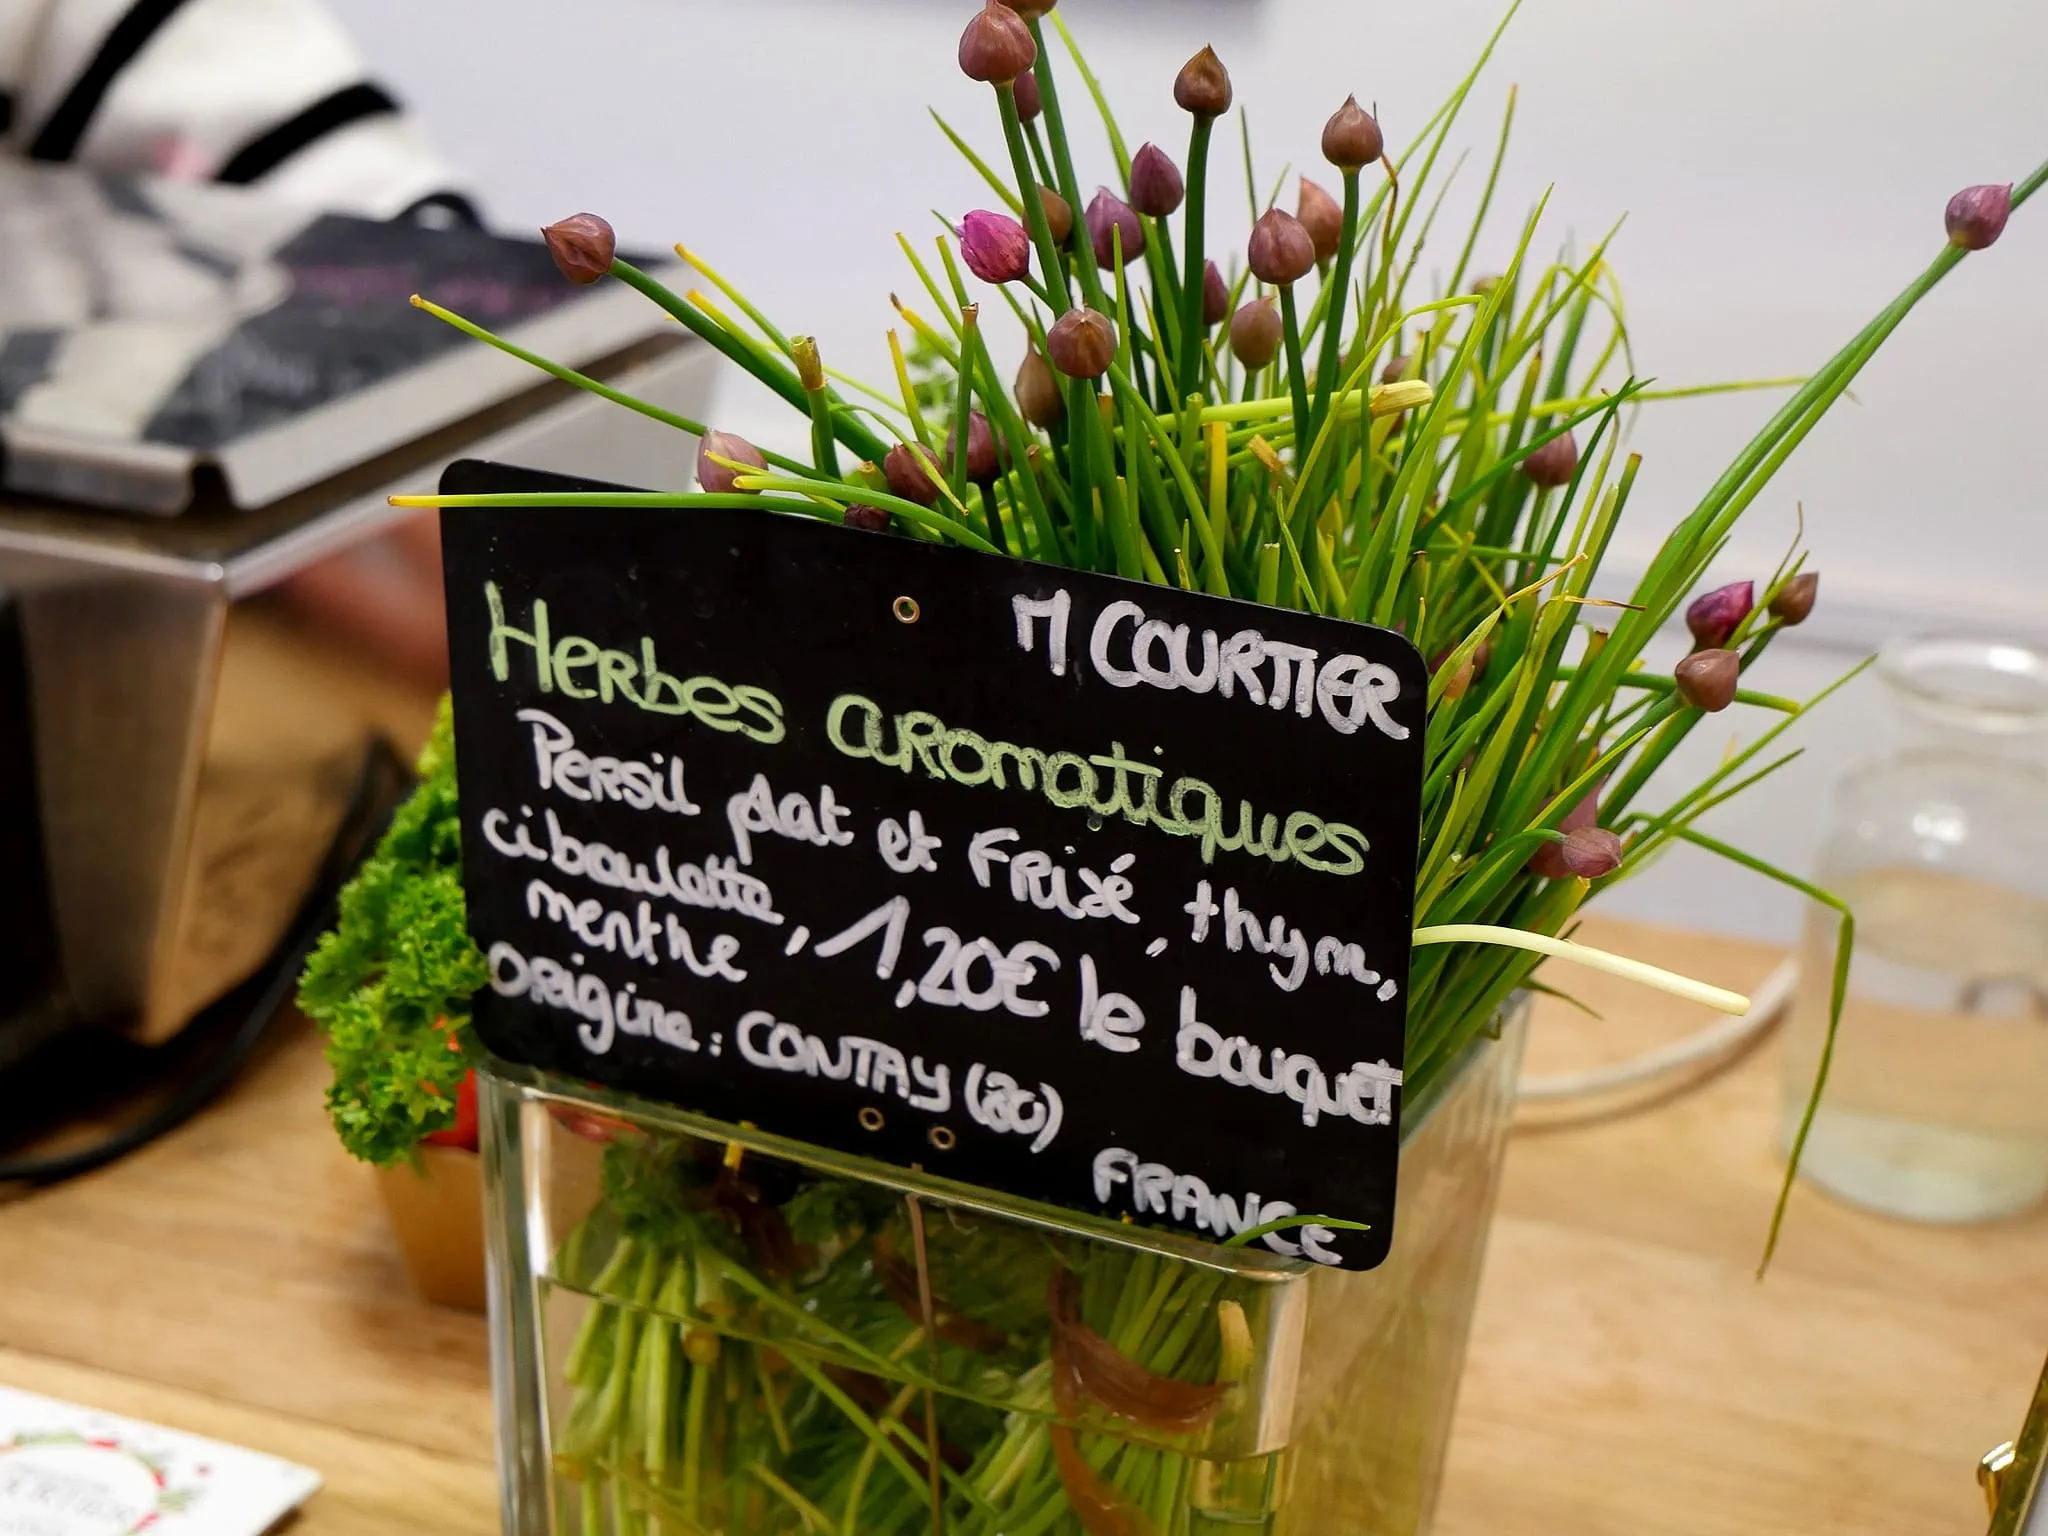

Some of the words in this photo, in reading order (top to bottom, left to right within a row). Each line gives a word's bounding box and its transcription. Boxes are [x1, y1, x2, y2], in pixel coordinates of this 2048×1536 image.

[485, 580, 786, 744] Herbes
[827, 693, 1370, 875] aromatiques
[1012, 588, 1071, 676] M
[1090, 600, 1410, 740] COURTIER
[516, 708, 700, 816] Persil
[727, 773, 854, 866] plat
[877, 810, 943, 873] et
[526, 879, 748, 983] menthe
[814, 895, 1061, 1017] 1,20€
[1080, 953, 1145, 1053] le
[1176, 985, 1403, 1127] bouquet
[736, 1010, 951, 1113] CONTAY
[1093, 1147, 1344, 1266] FRANCE
